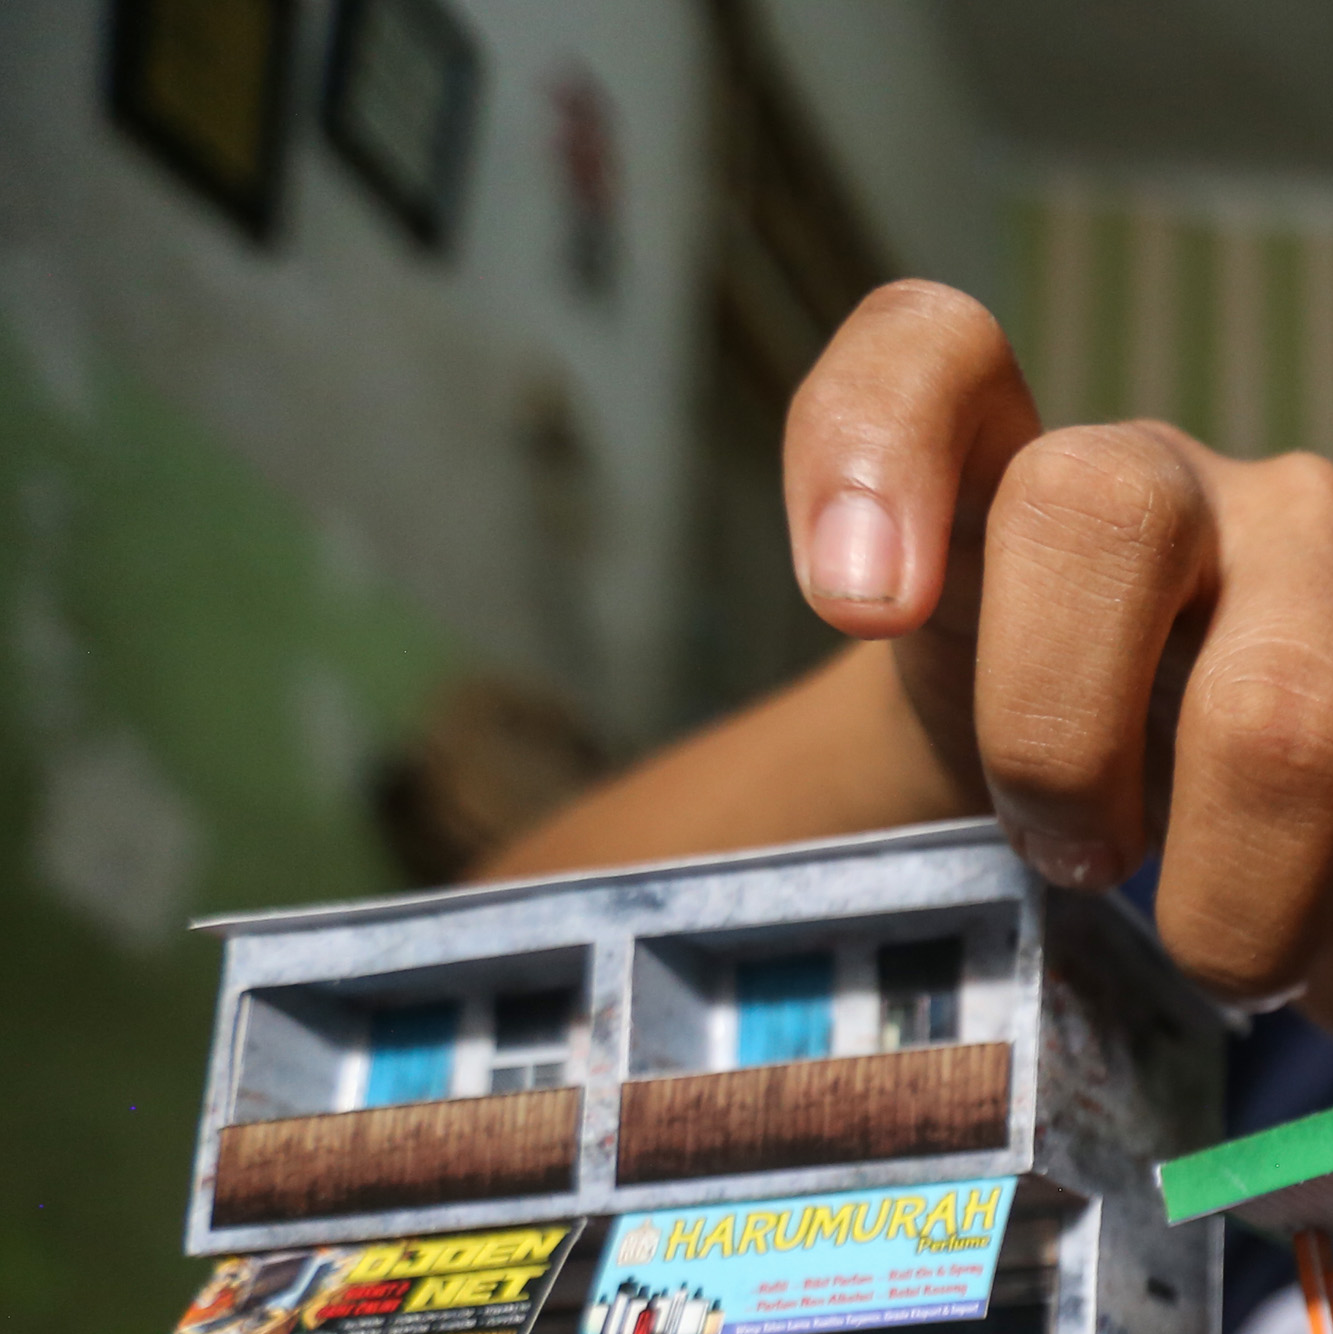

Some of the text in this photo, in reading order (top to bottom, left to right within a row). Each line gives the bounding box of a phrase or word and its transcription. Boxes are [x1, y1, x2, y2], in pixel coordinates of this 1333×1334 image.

[664, 1186, 1002, 1262] HARUMURAH
[917, 1232, 991, 1255] Perfume
[403, 1264, 551, 1313] NET
